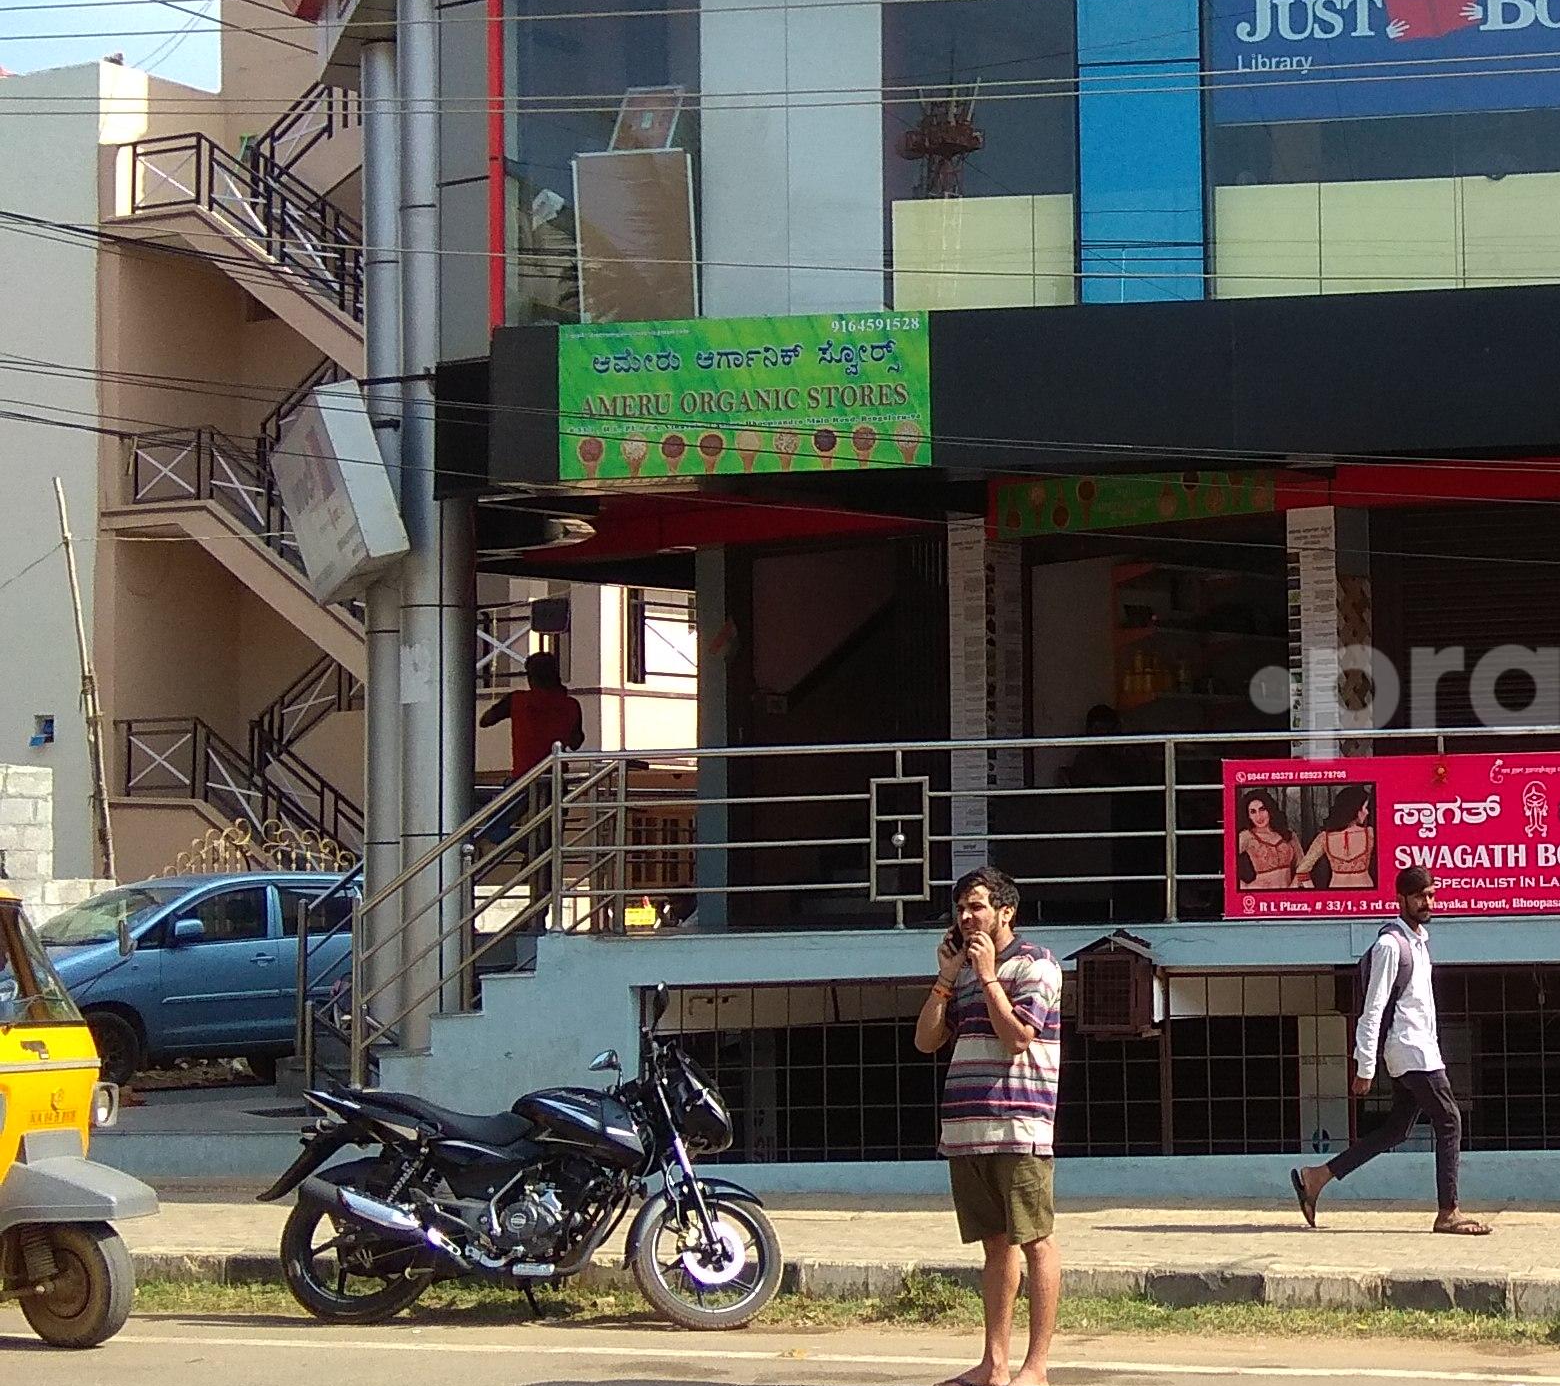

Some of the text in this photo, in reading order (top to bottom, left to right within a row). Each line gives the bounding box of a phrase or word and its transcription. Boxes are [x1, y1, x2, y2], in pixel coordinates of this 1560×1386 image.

[1237, 53, 1312, 75] Library
[831, 317, 920, 333] 9164591528
[581, 382, 909, 417] AMERU ORGANIC STORES
[1394, 843, 1527, 869] SWAGATH
[1259, 902, 1267, 911] R
[1270, 902, 1277, 911] L
[1280, 901, 1311, 912] Plaza,
[1315, 901, 1322, 910] #
[1326, 900, 1357, 911] 33/1,
[1359, 900, 1367, 910] 3
[1370, 900, 1382, 909] rd
[1470, 898, 1509, 910] Layout,
